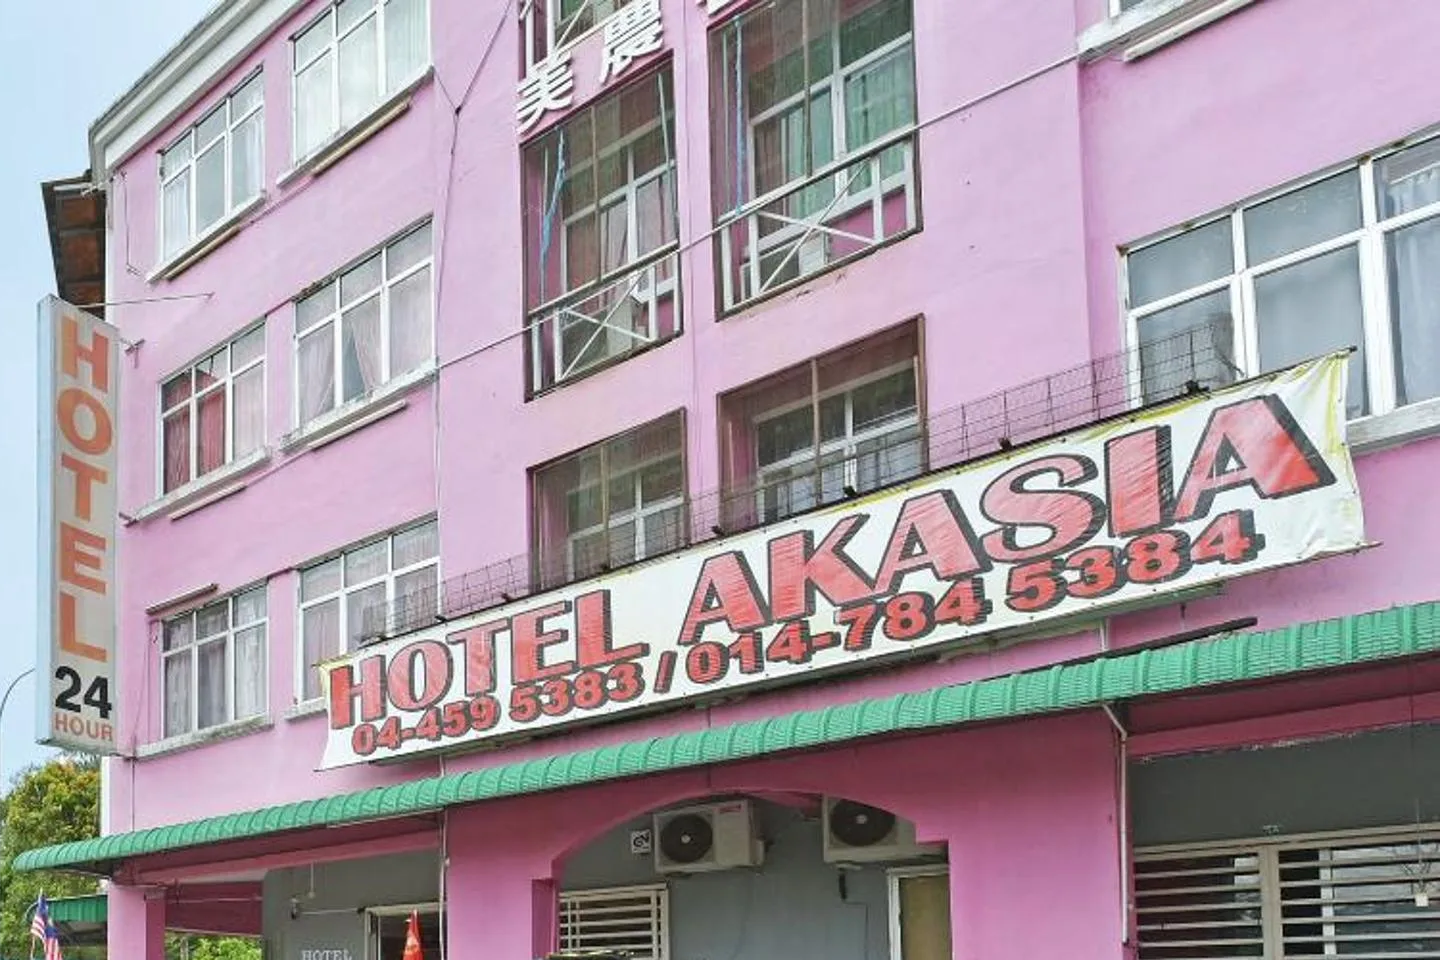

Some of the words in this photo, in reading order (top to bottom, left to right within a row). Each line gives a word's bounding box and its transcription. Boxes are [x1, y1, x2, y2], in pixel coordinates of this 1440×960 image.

[56, 315, 113, 663] HOTEL
[329, 588, 650, 730] HOTEL
[677, 393, 1338, 646] AKASIA
[55, 665, 112, 719] 24
[55, 711, 113, 742] HOUR
[351, 694, 501, 756] 04-459
[1005, 509, 1266, 613] 5384
